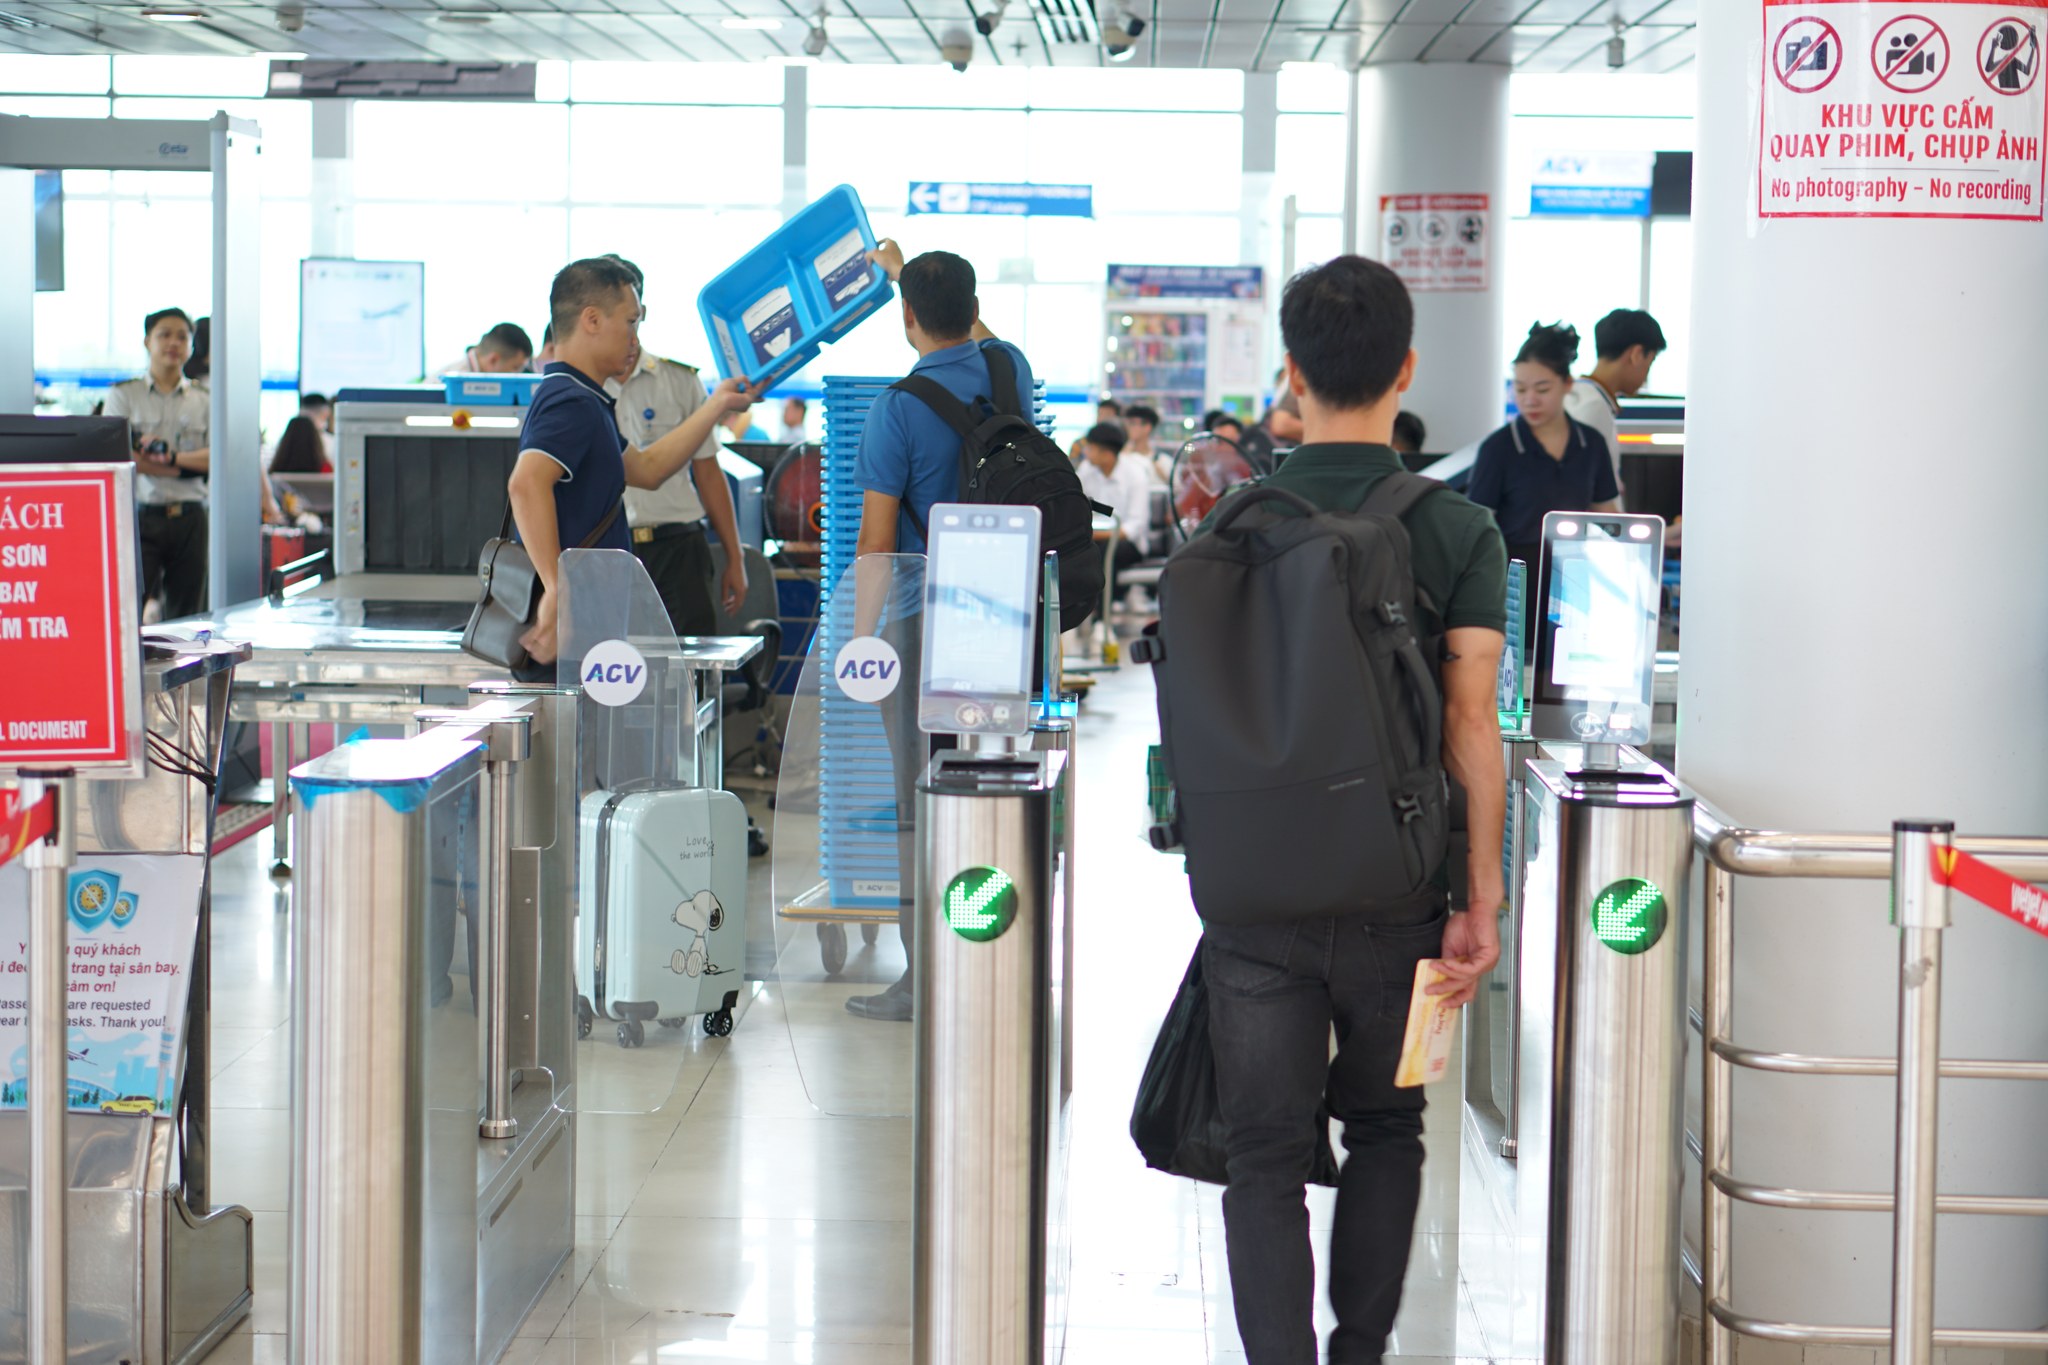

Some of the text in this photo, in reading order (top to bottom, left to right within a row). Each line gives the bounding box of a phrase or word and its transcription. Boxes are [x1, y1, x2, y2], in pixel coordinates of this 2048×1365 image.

[1822, 96, 1993, 132] KHU VỰC CẤM
[1771, 129, 2037, 163] QUAY PHIM, CHỤP ẢNH
[1772, 178, 1790, 198] No
[1796, 176, 1908, 202] photography
[1930, 178, 1951, 198] No
[1957, 178, 2031, 205] recording
[2, 543, 47, 567] SƠN
[0, 581, 38, 603] BAY
[28, 616, 69, 638] TRA
[585, 663, 643, 684] ACV
[839, 660, 896, 680] ACV
[8, 720, 88, 741] DOCUMENT
[686, 836, 707, 846] Love
[680, 850, 690, 860] the
[74, 943, 98, 958] quý
[102, 944, 141, 956] khách
[72, 962, 105, 977] trang
[110, 962, 125, 977] tại
[155, 962, 180, 976] bay.
[68, 999, 151, 1012] are requested
[0, 1016, 21, 1026] ear
[101, 1016, 137, 1028] Thank
[141, 1016, 166, 1031] you!
